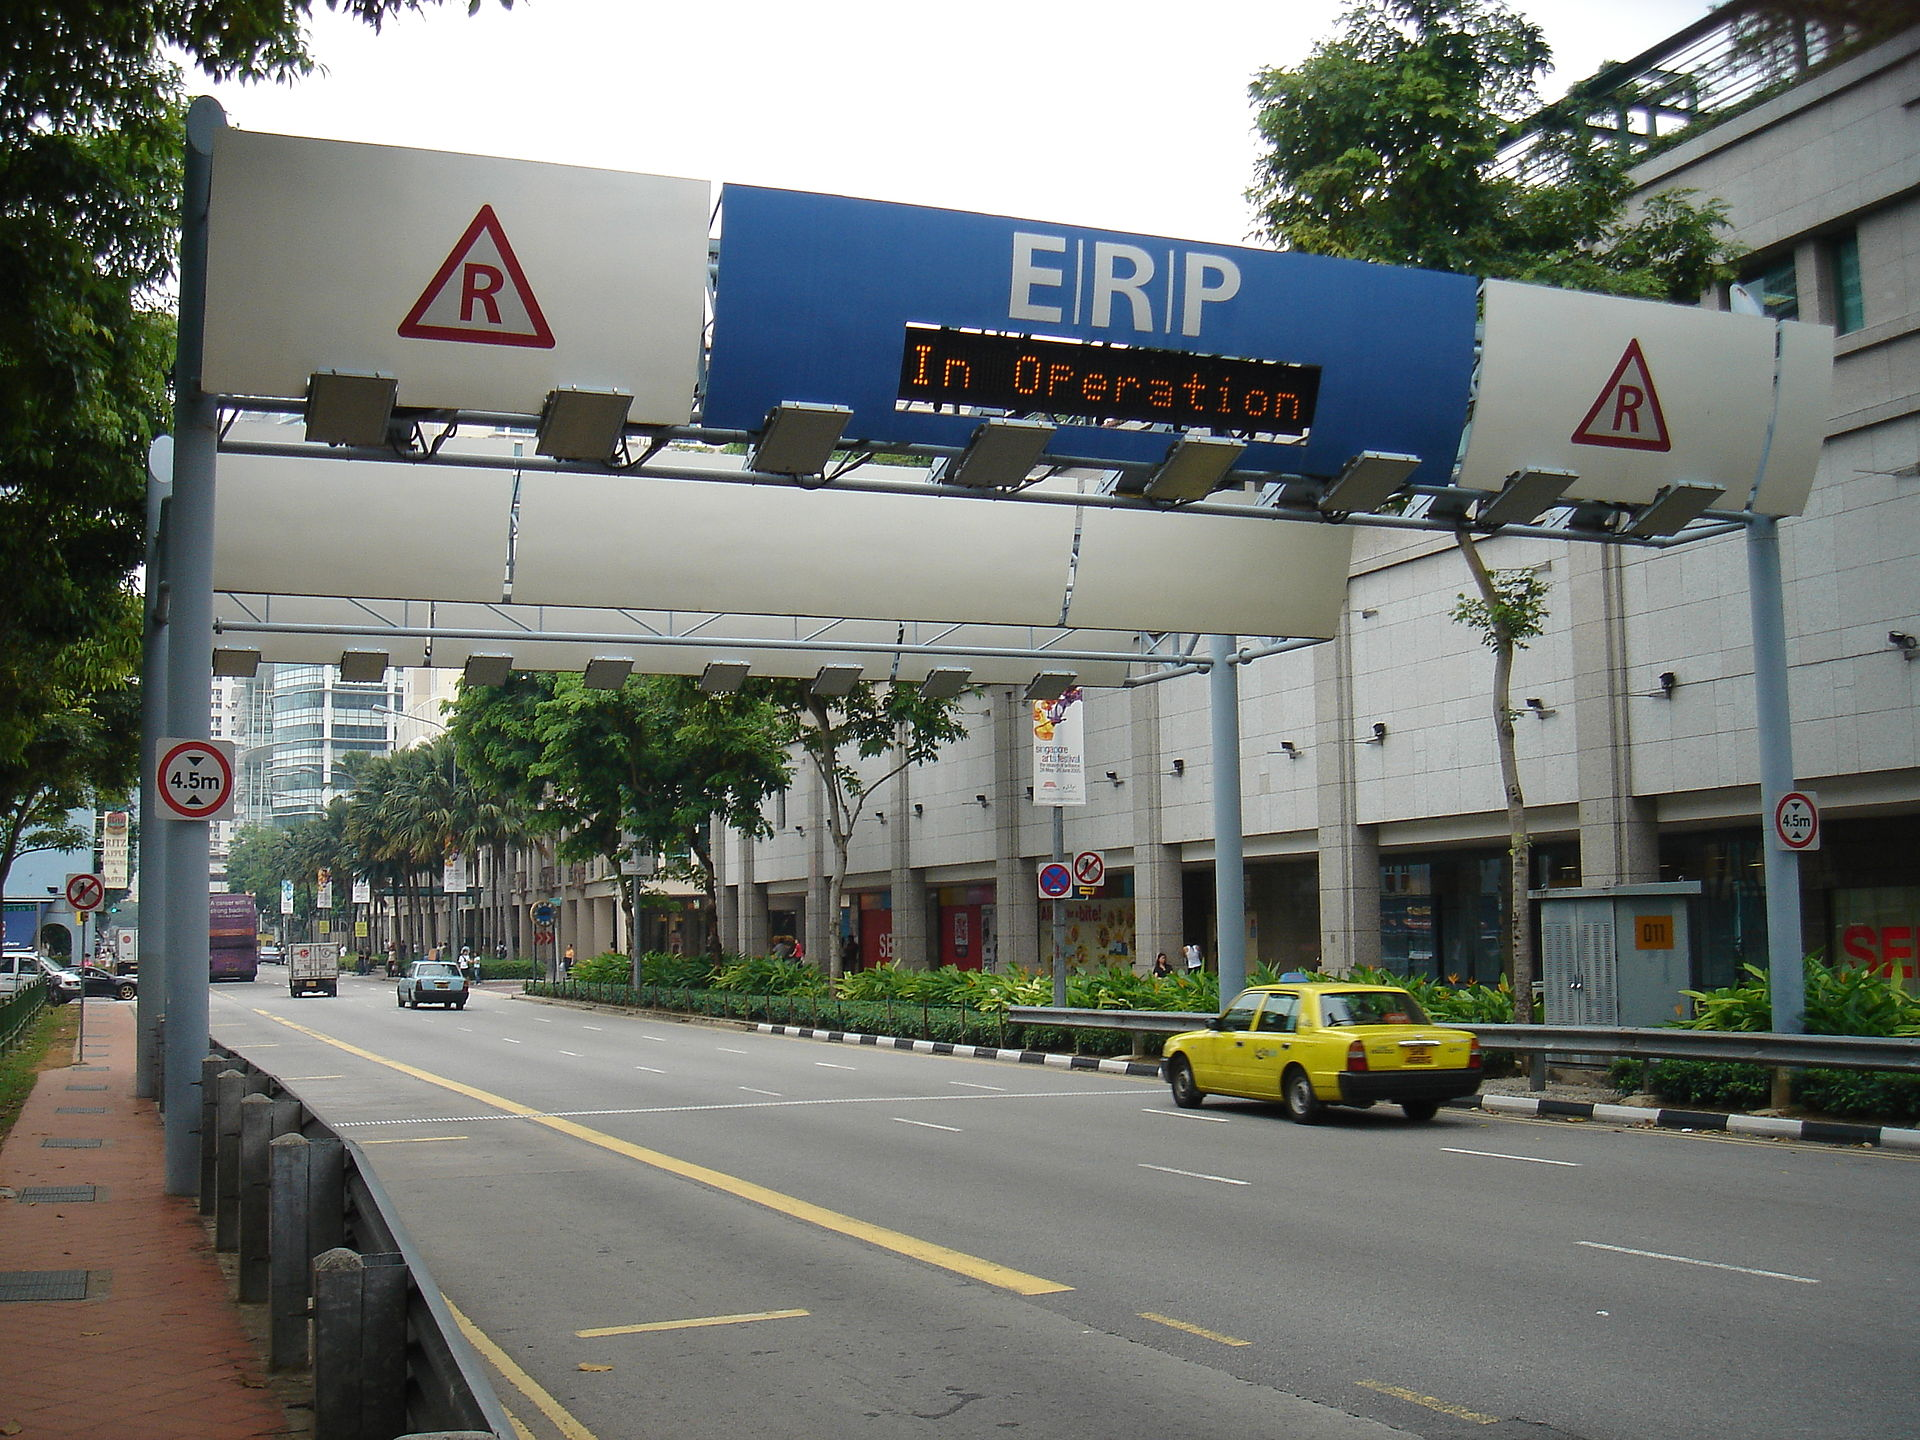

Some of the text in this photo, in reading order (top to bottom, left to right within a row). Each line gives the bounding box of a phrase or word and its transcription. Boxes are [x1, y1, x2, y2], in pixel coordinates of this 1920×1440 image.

[460, 262, 504, 324] R
[911, 343, 1301, 420] In Operation
[1612, 384, 1644, 433] R
[1035, 745, 1068, 755] singapore
[170, 771, 220, 791] 4.5m
[1782, 813, 1811, 828] 4.5m
[106, 839, 127, 848] RITZ
[1079, 904, 1102, 921] bite!
[1642, 923, 1666, 943] 011
[1843, 925, 1920, 979] SE
